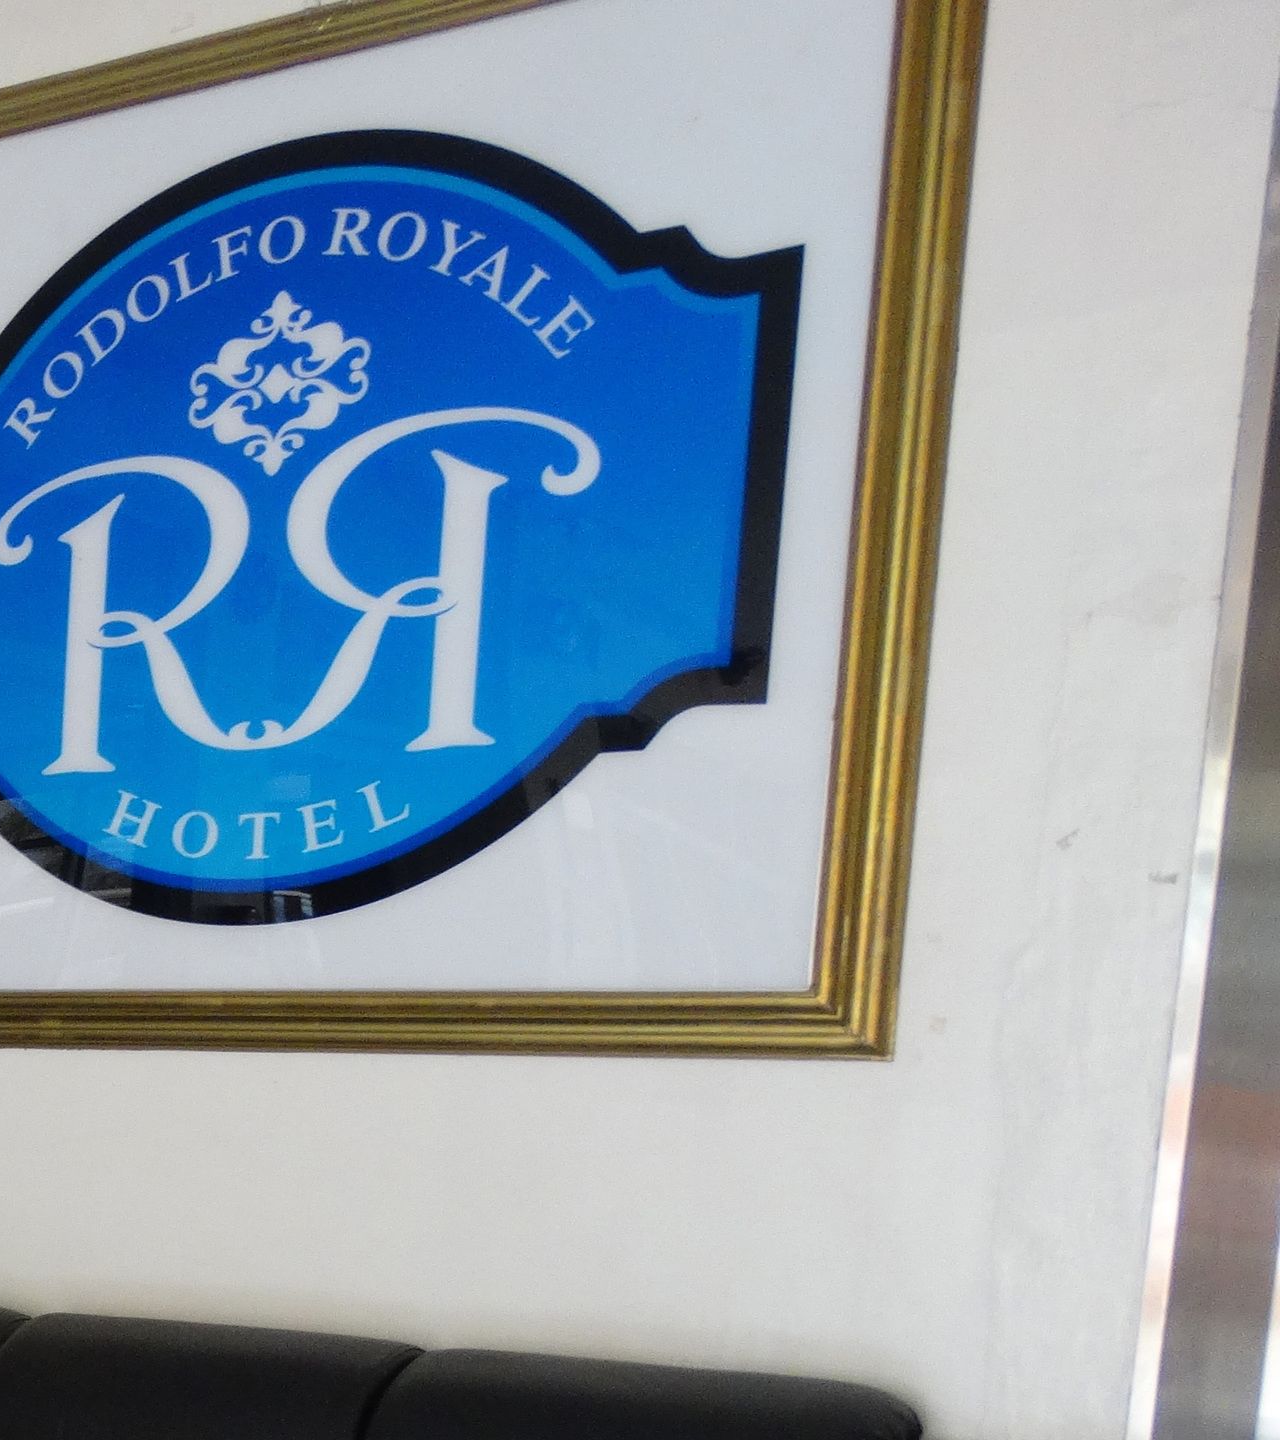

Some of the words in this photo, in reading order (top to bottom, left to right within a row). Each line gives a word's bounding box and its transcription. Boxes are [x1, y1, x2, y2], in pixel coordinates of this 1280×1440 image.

[4, 214, 307, 449] RODOLFO
[322, 206, 597, 360] ROYALE
[102, 779, 410, 861] HOTEL
